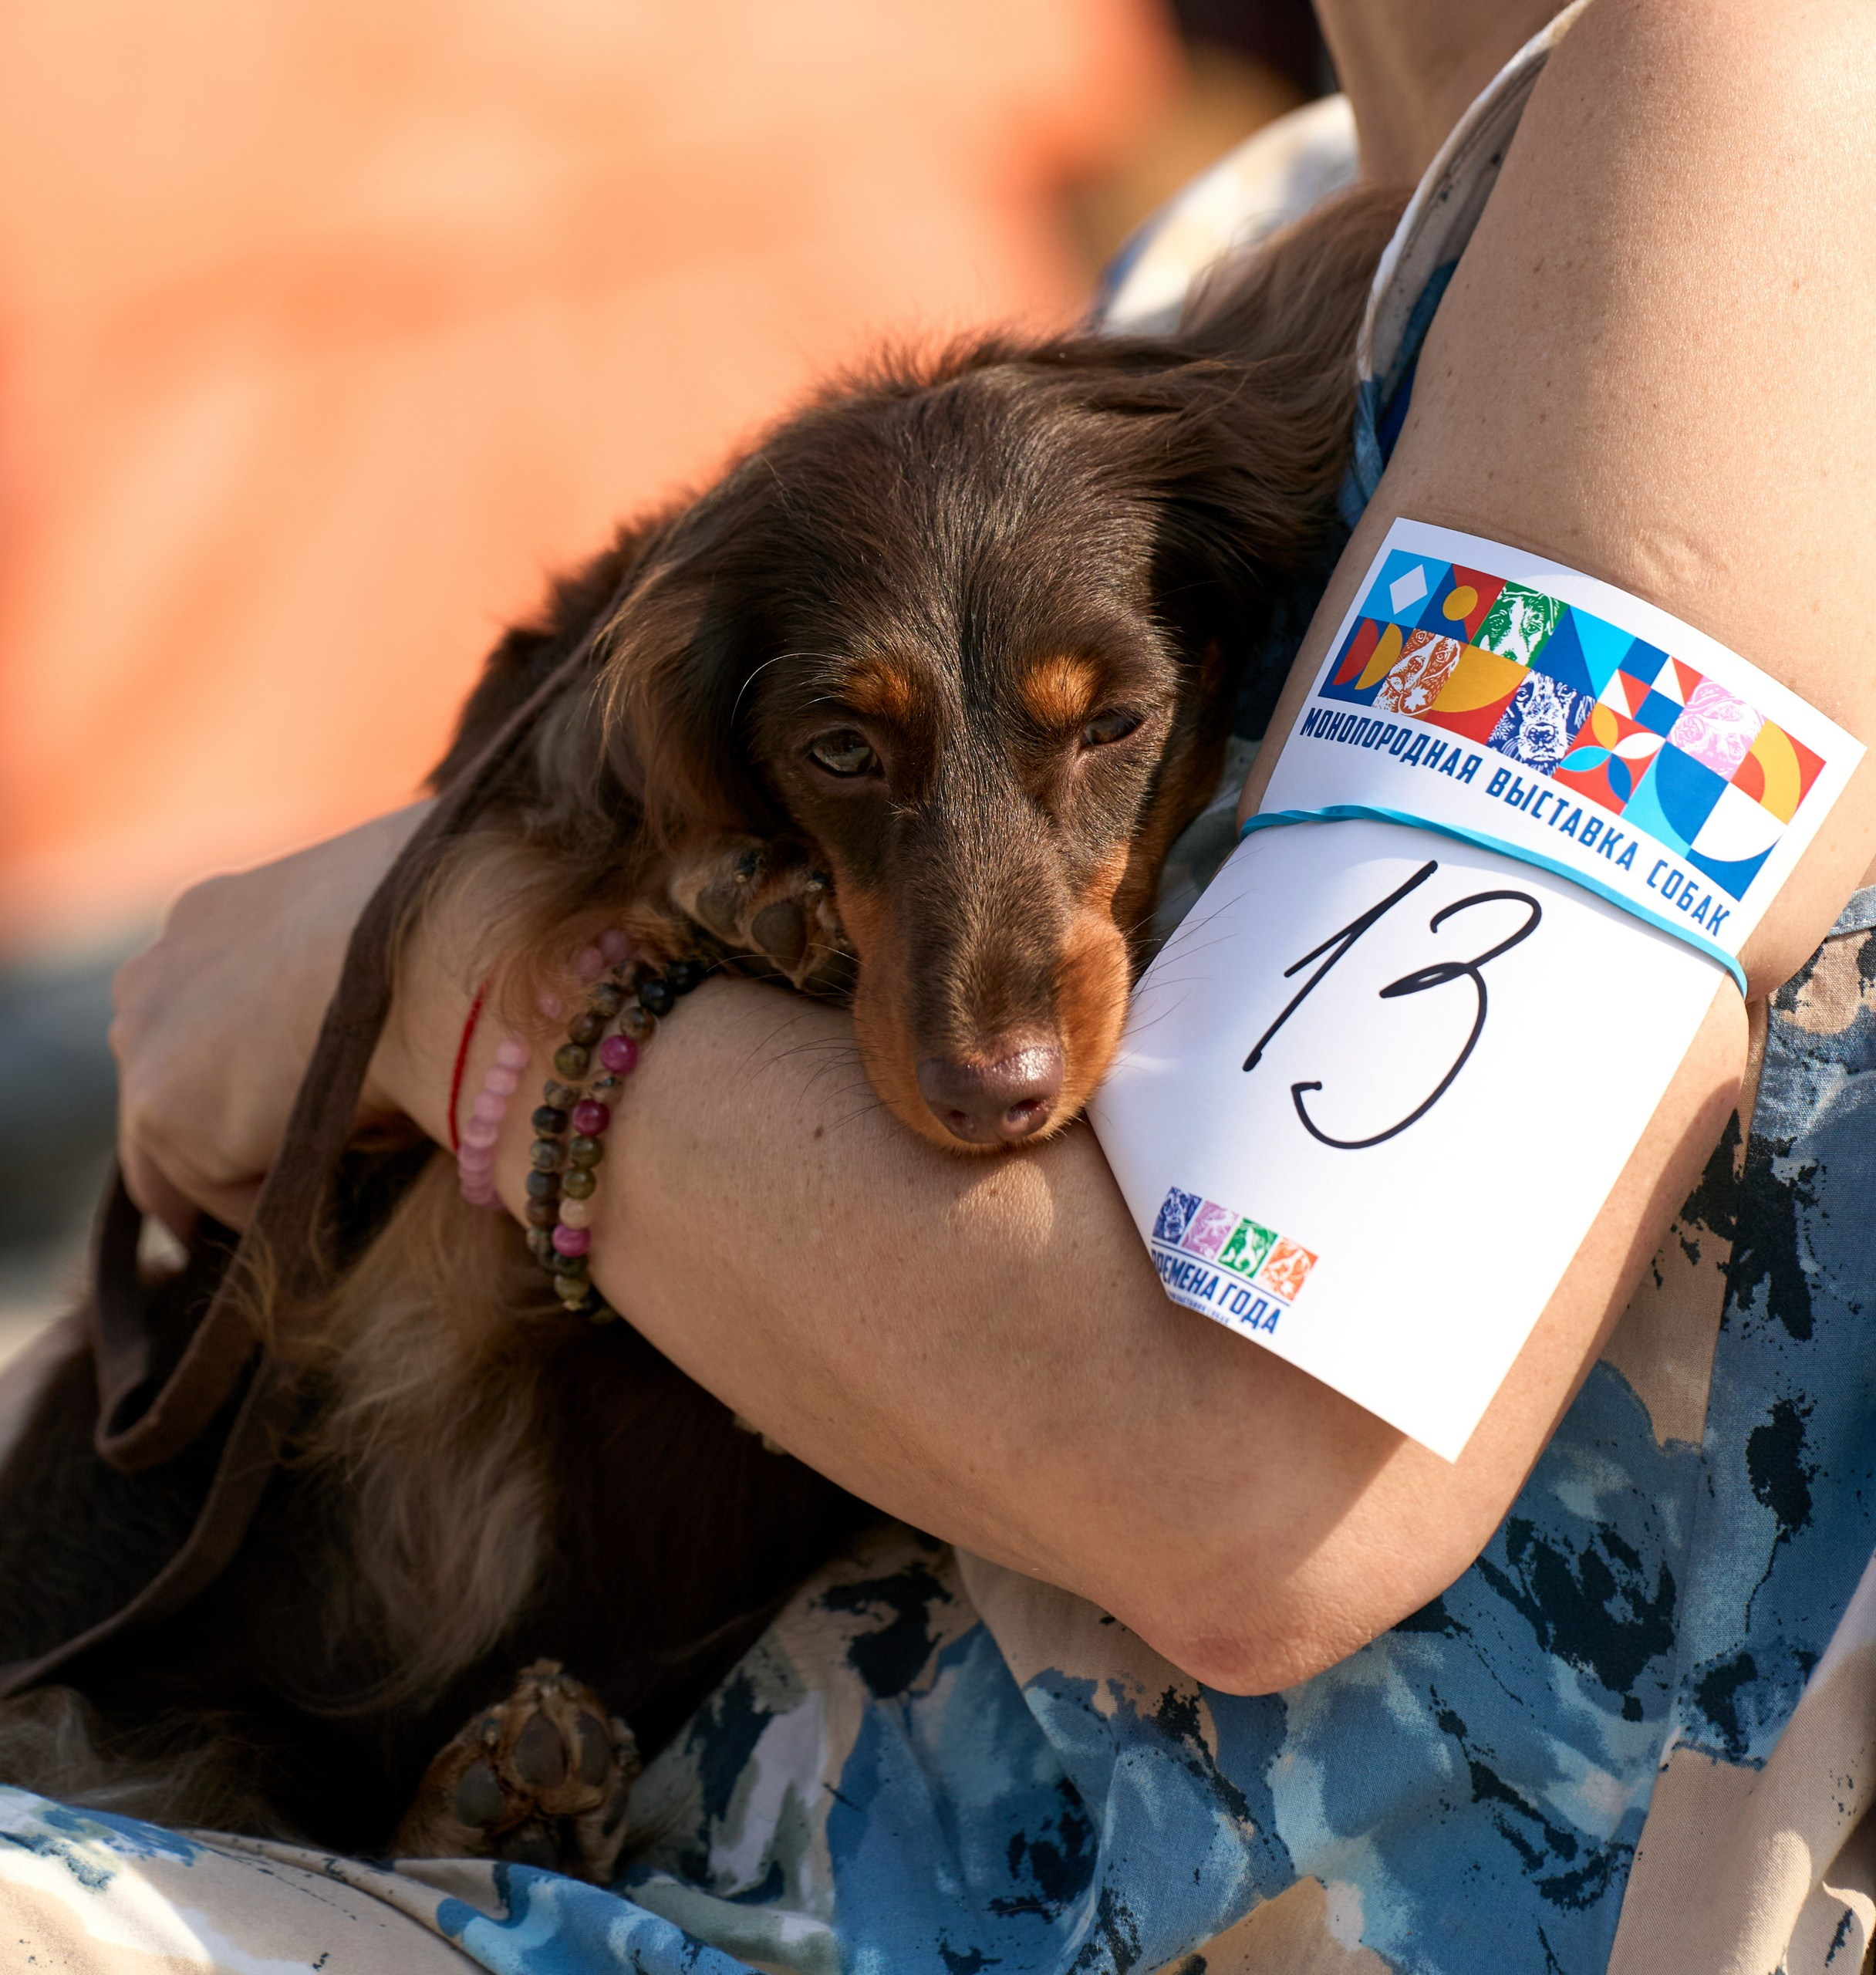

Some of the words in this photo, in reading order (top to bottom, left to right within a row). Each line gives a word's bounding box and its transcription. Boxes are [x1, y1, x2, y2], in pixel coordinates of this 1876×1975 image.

[1299, 707, 1483, 785] МОНОПОРОДНАЯ
[1485, 771, 1642, 872] ВЫСТАВКА
[1645, 859, 1730, 937] СОБАК
[1242, 859, 1542, 1150] 13
[1217, 1282, 1281, 1335] ГОДА
